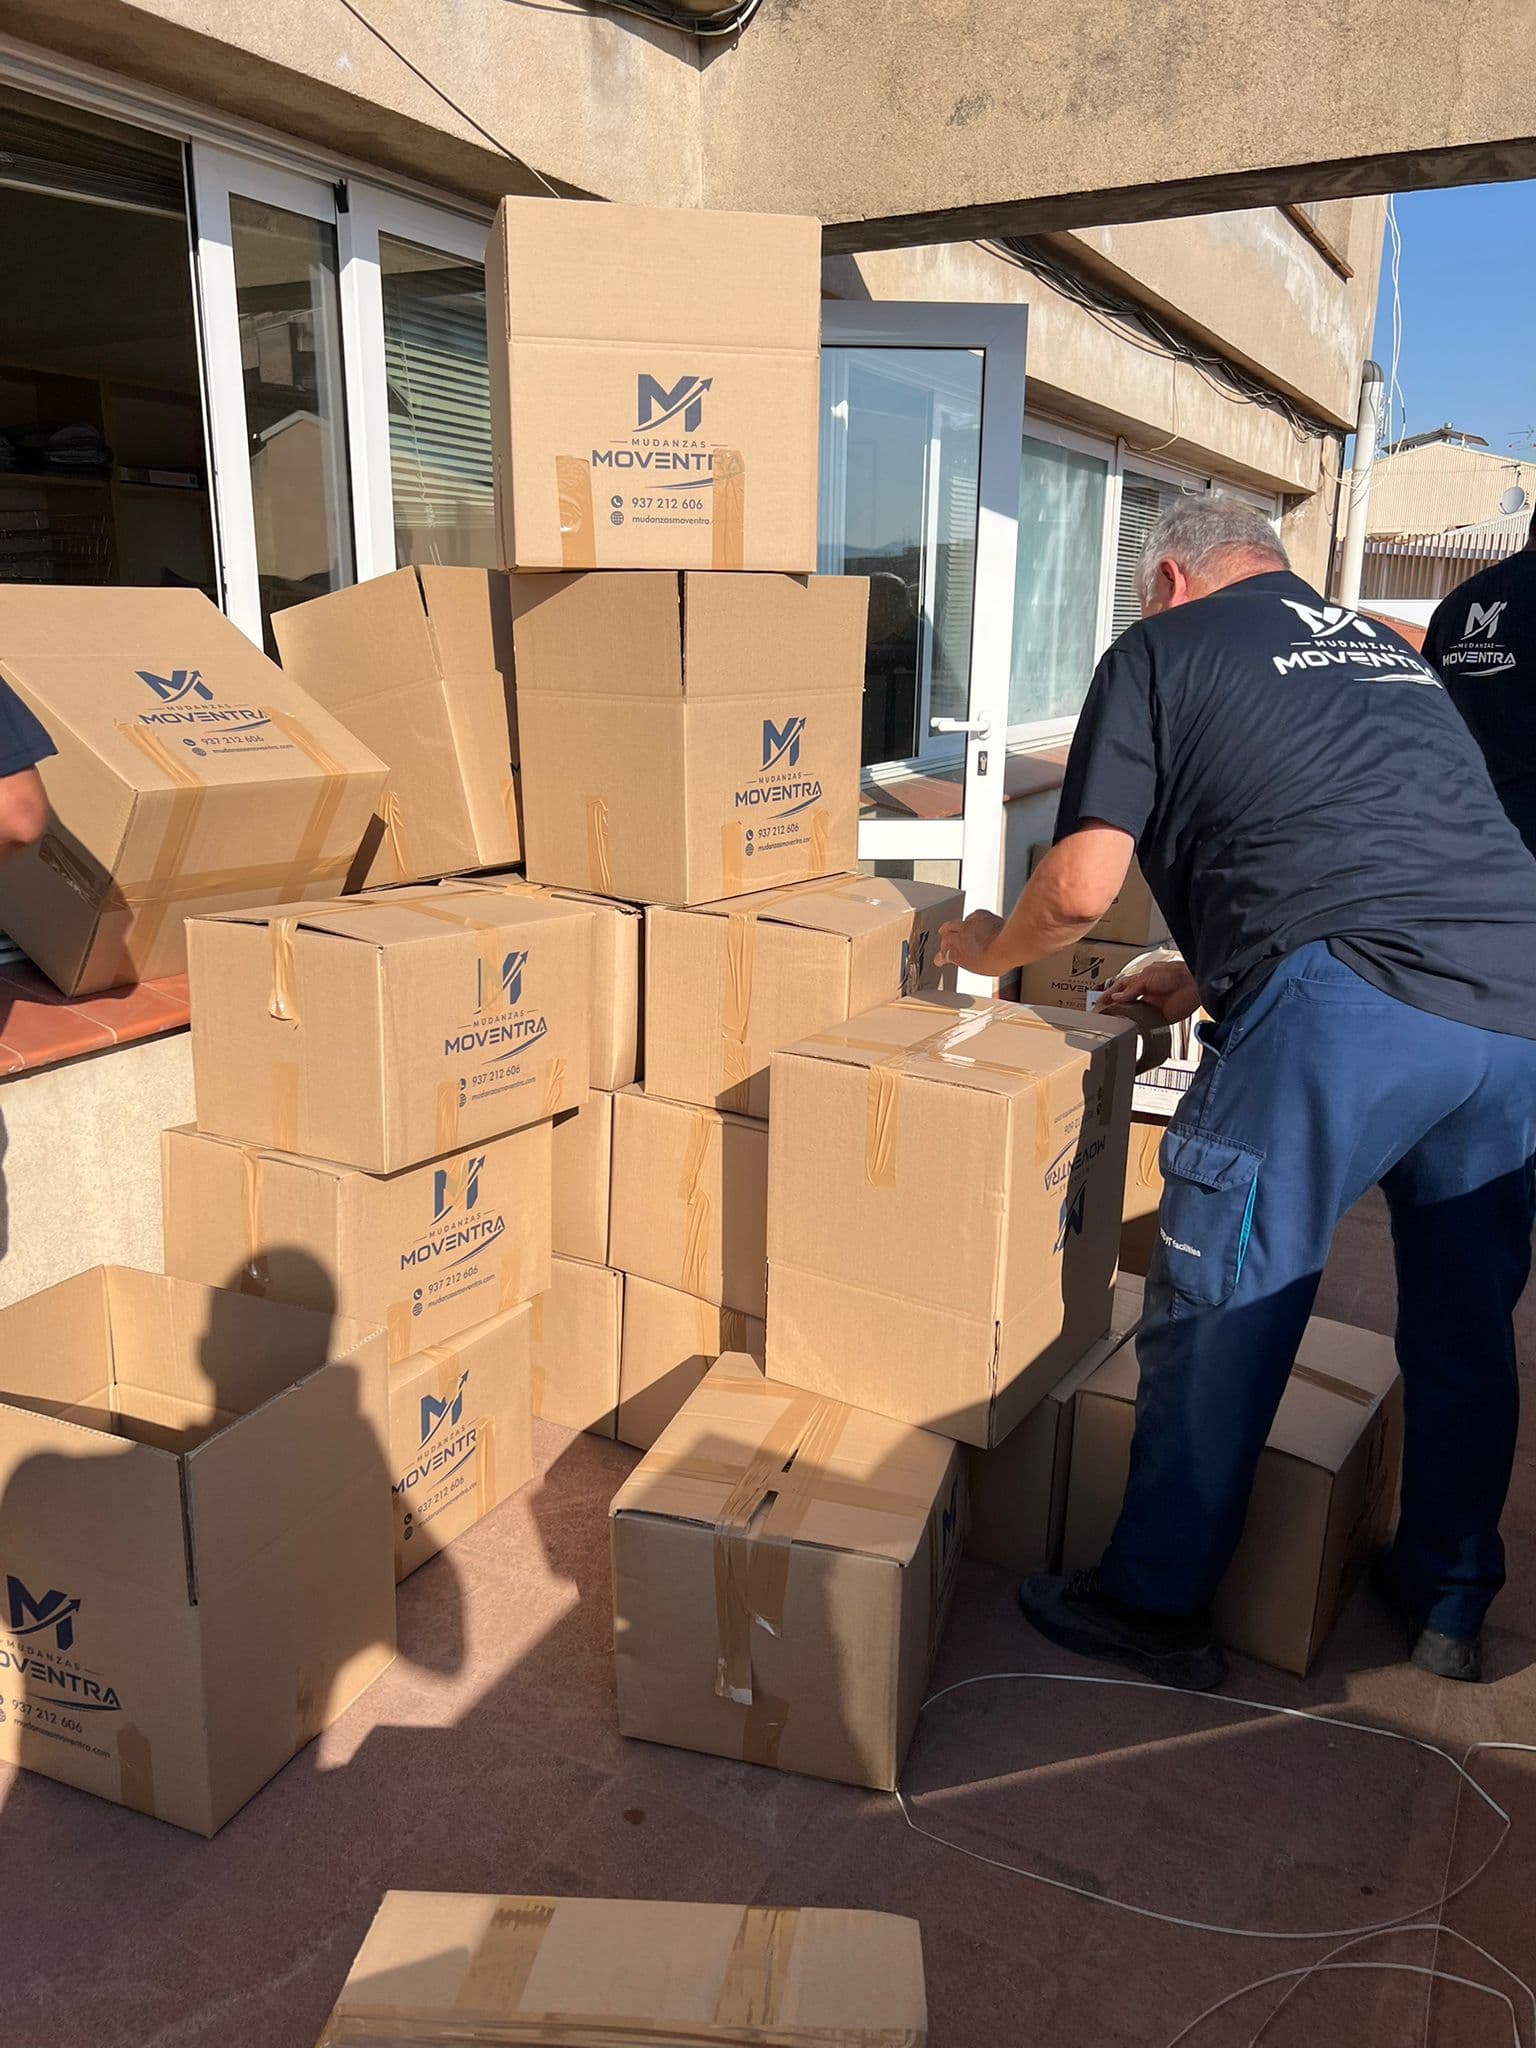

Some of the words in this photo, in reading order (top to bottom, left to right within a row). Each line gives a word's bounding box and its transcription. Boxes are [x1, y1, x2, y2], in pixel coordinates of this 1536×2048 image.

[631, 438, 706, 449] MUDANZAS
[592, 449, 713, 470] MOVENT
[631, 497, 653, 508] 937
[657, 498, 678, 509] 212
[682, 499, 703, 510] 606
[632, 515, 713, 525] mudanzasmoventra.
[1314, 639, 1396, 652] MUDANZAS
[1442, 651, 1516, 667] MOVENTRA
[166, 703, 232, 711] MUDANZAS
[200, 737, 221, 745] 937
[222, 736, 243, 744] 212
[758, 772, 803, 784] MUDANZAS
[735, 780, 823, 808] MOVENTRA
[757, 827, 771, 838] 937
[772, 825, 785, 836] 212
[786, 822, 799, 834] 606
[472, 1010, 526, 1027] MUDANZAS
[444, 1016, 548, 1056] MOVENTRA
[472, 1073, 488, 1087] 937
[489, 1068, 505, 1082] 212
[505, 1064, 521, 1077] 606
[1044, 1135, 1106, 1191] MOVENTRA
[428, 1212, 482, 1239] MUDANZAS
[400, 1215, 506, 1271] MOVENTRA
[428, 1279, 444, 1294] 937
[446, 1272, 462, 1287] 212
[463, 1265, 479, 1279] 606
[416, 1425, 466, 1462] MUDANZAS
[391, 1428, 476, 1495] MOVENTR
[416, 1498, 432, 1513] 937
[434, 1487, 449, 1504] 212
[450, 1476, 465, 1492] 606
[6, 1639, 80, 1671] MUDANZAS
[0, 1650, 121, 1707] OVENTRA
[12, 1699, 33, 1715] 937
[36, 1707, 58, 1724] 212
[61, 1717, 82, 1733] 606
